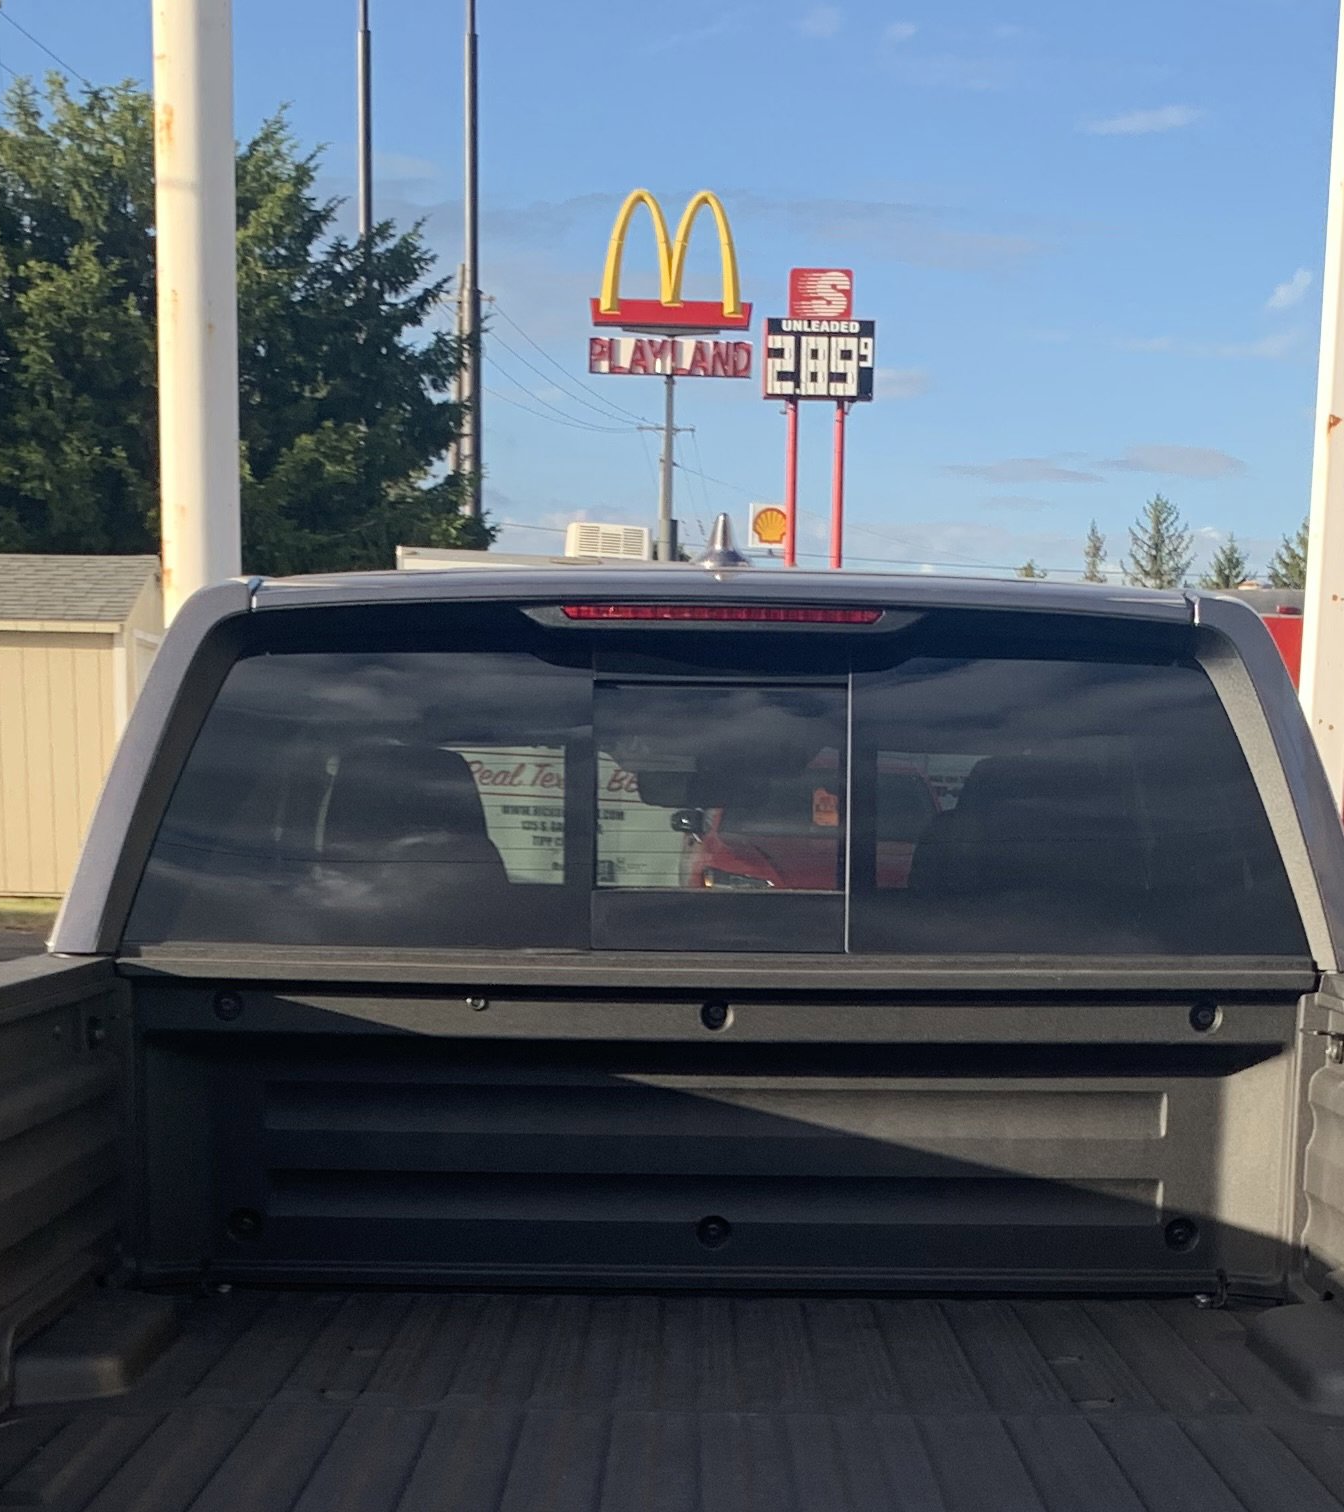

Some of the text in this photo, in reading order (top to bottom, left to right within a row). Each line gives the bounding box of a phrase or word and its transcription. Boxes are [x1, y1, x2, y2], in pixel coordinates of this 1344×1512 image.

[781, 319, 861, 333] UNLEADED
[589, 337, 753, 378] PLAYLAND
[467, 760, 525, 787] Real
